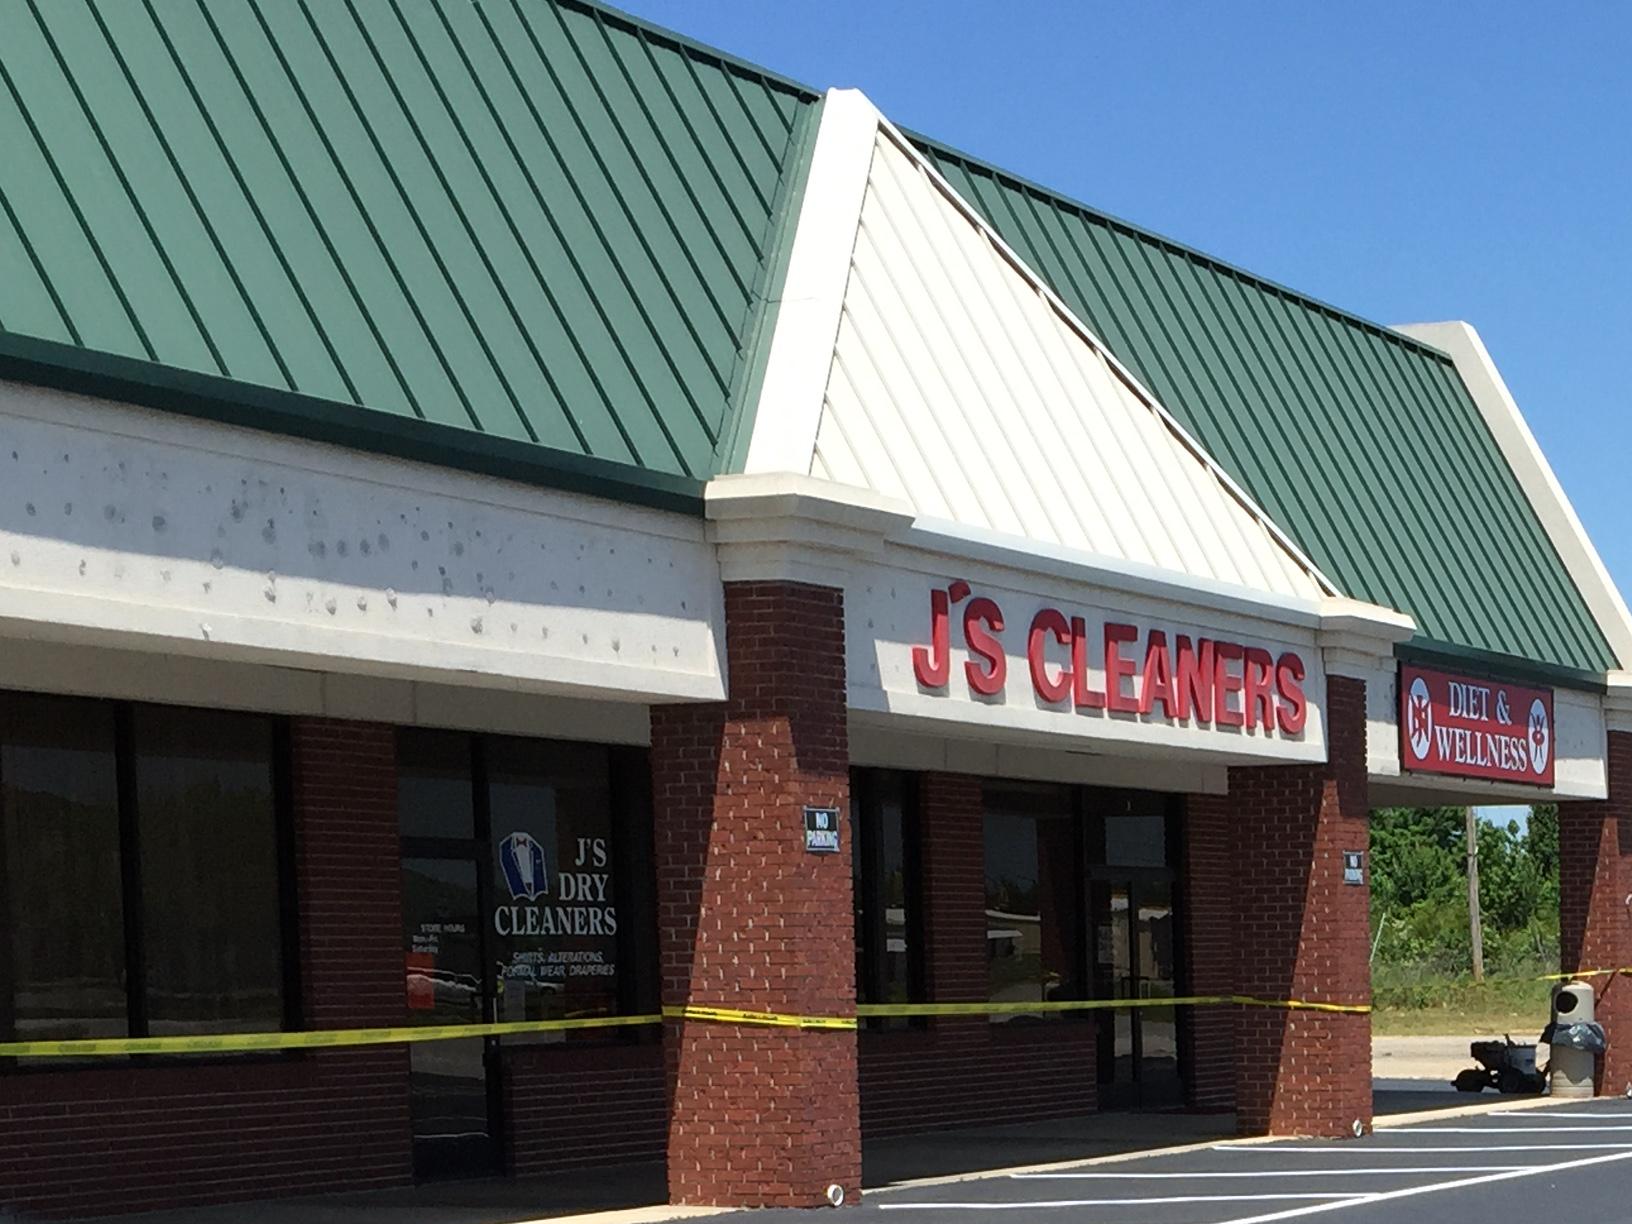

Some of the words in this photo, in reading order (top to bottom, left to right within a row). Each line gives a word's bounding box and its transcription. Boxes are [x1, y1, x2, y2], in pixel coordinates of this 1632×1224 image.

[912, 579, 1008, 697] J'S
[1027, 608, 1308, 736] CLEANERS
[1448, 681, 1491, 723] DIET
[1496, 689, 1513, 727] &
[1434, 724, 1528, 773] WELLNESS
[815, 811, 829, 830] NO
[574, 837, 607, 868] J'S
[806, 830, 838, 850] PARKING
[558, 871, 609, 902] DRY
[494, 906, 618, 937] CLEANERS
